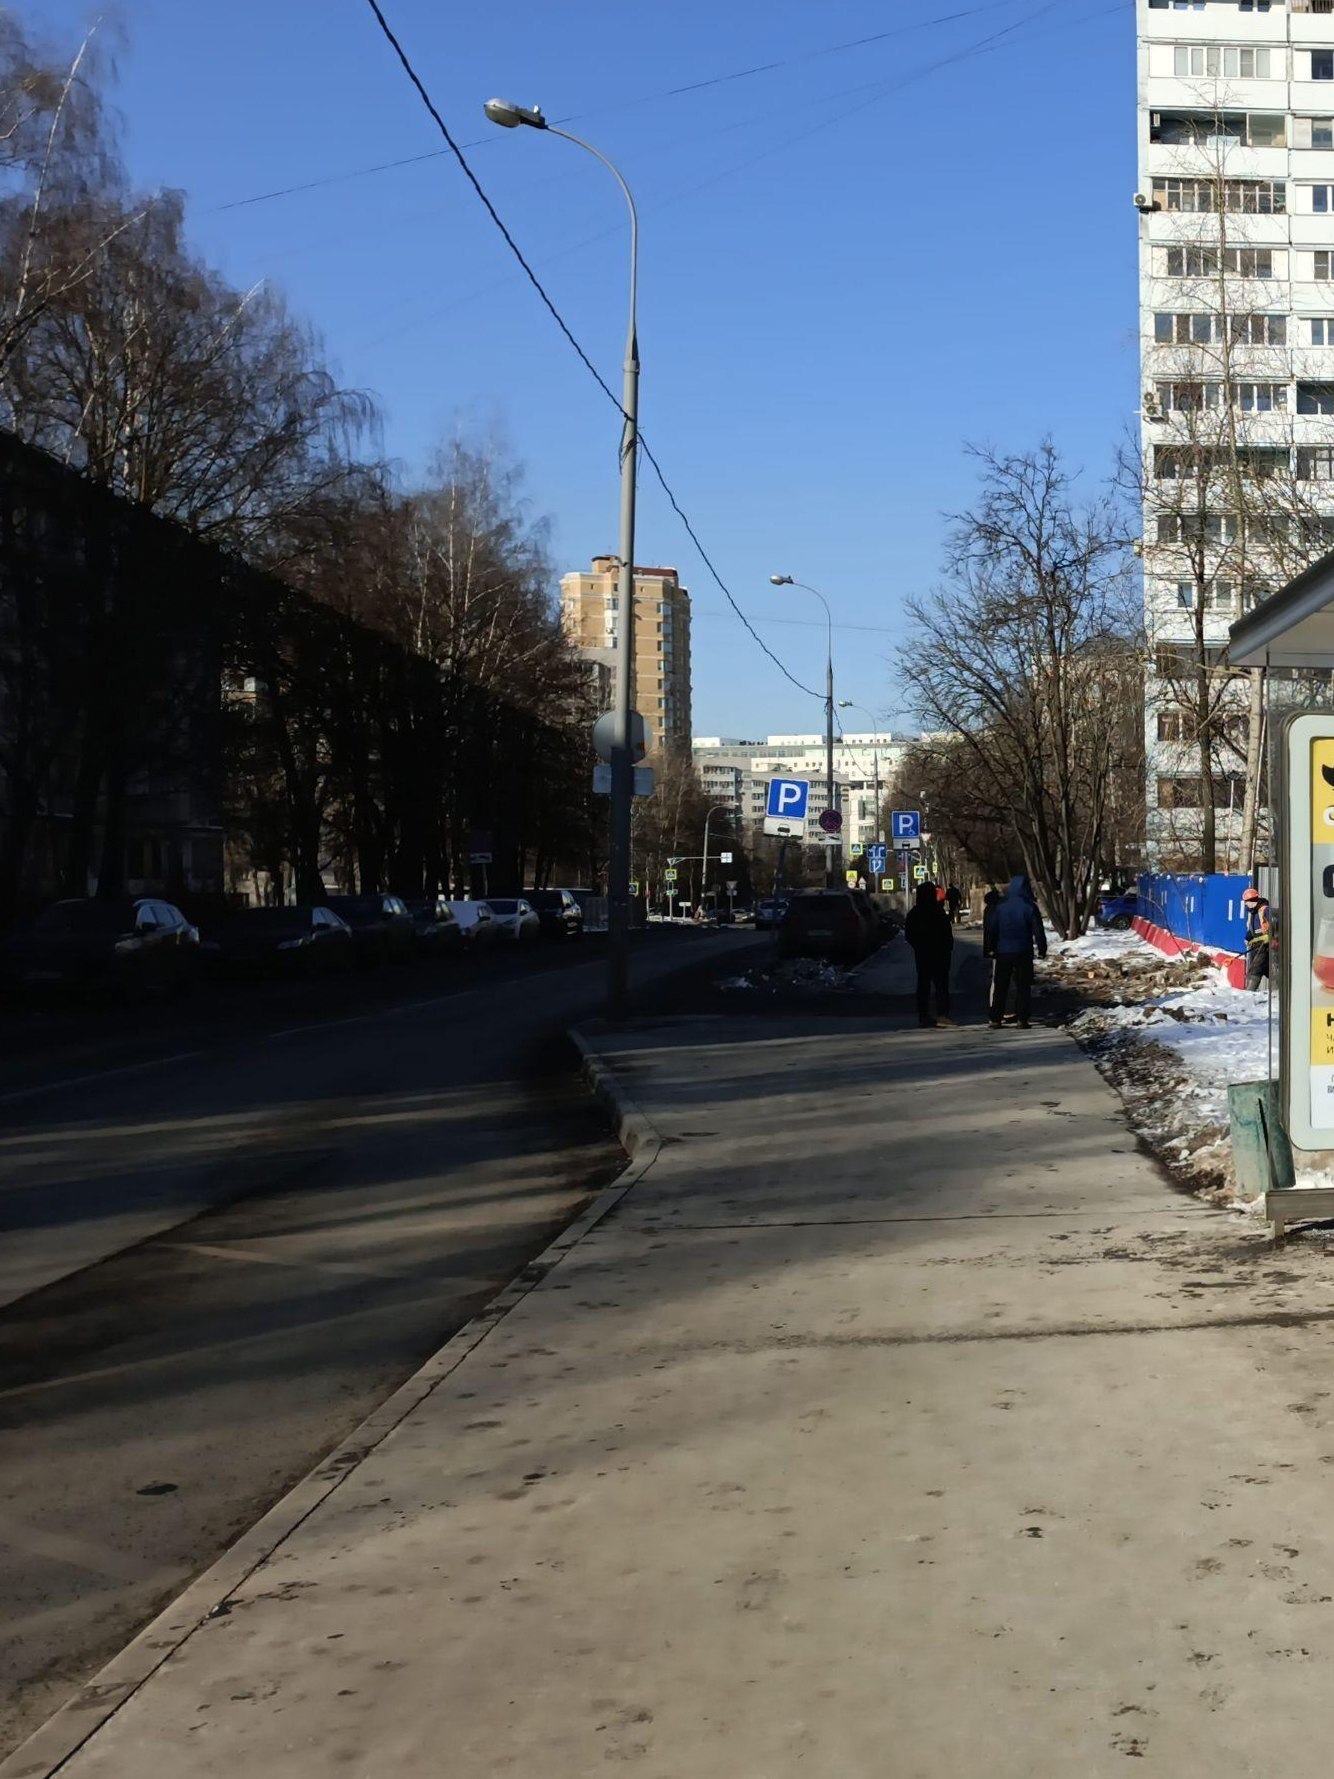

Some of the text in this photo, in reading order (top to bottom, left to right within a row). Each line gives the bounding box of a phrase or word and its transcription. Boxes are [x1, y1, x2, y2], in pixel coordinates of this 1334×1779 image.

[778, 783, 801, 813] P
[899, 814, 913, 834] P
[1327, 1045, 1334, 1054] И
